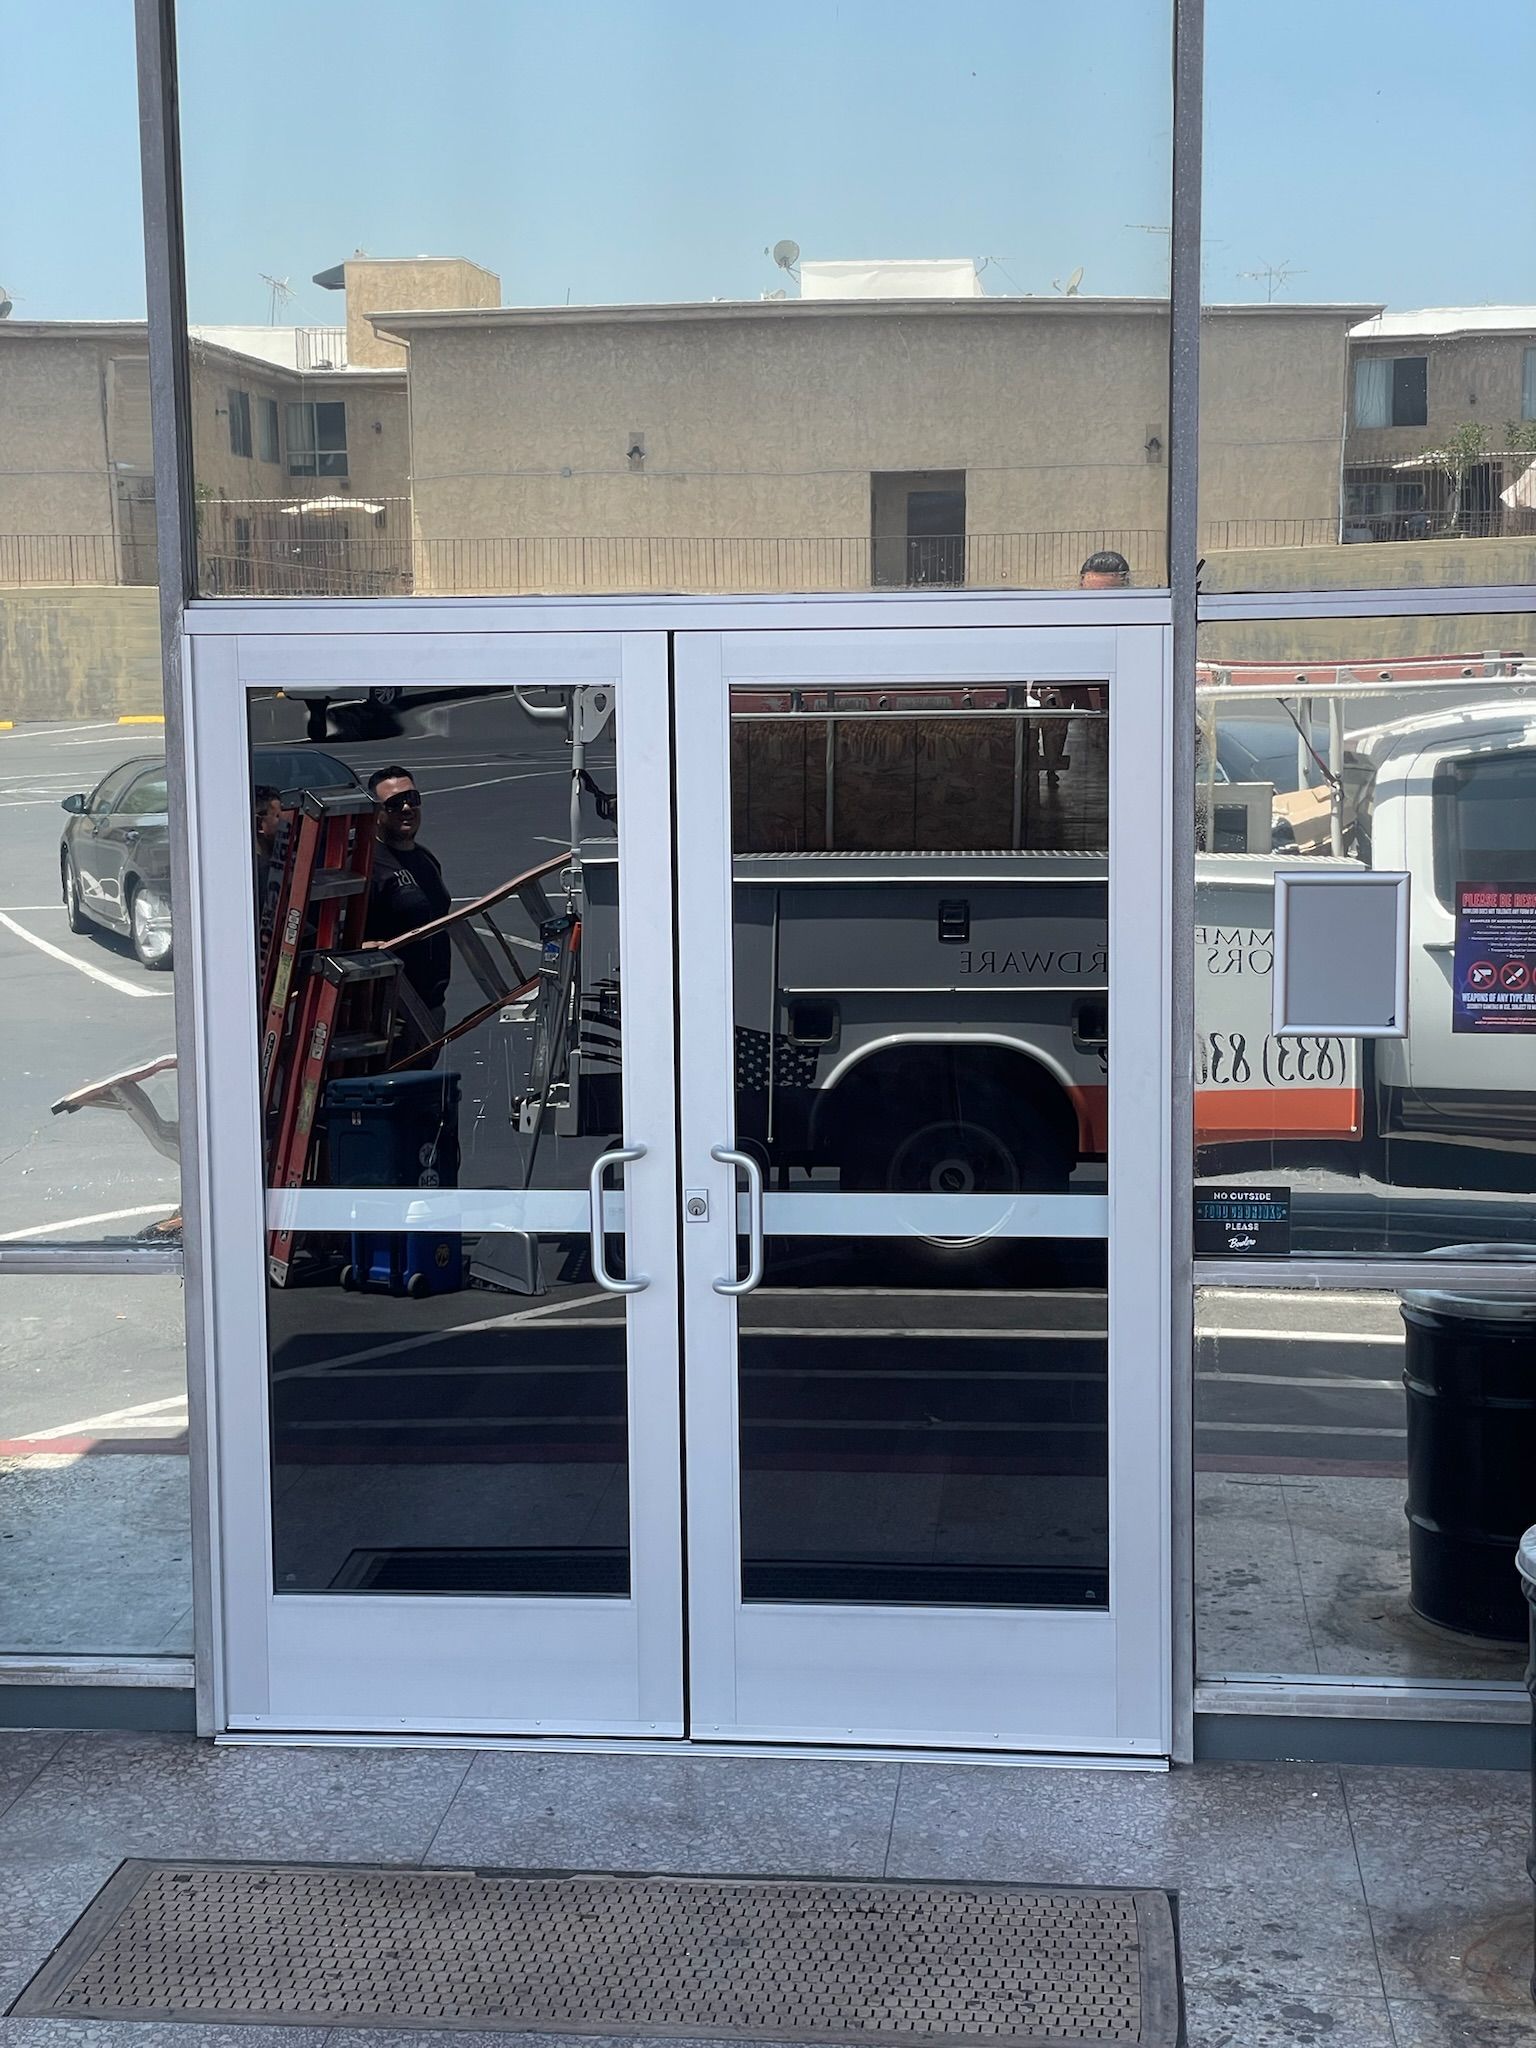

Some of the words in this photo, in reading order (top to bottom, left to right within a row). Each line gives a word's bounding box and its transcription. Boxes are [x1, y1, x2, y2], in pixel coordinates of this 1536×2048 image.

[1462, 893, 1497, 907] PLEASE
[1499, 893, 1512, 907] BE
[1462, 993, 1488, 1002] WEAPONS
[1489, 993, 1496, 1002] OF
[1497, 993, 1508, 1002] ANY
[1510, 993, 1523, 1002] TYPE
[1524, 993, 1534, 1002] ARE
[1213, 1192, 1228, 1200] NO
[1230, 1192, 1271, 1200] OUTSIDE
[1225, 1222, 1259, 1231] PLEASE
